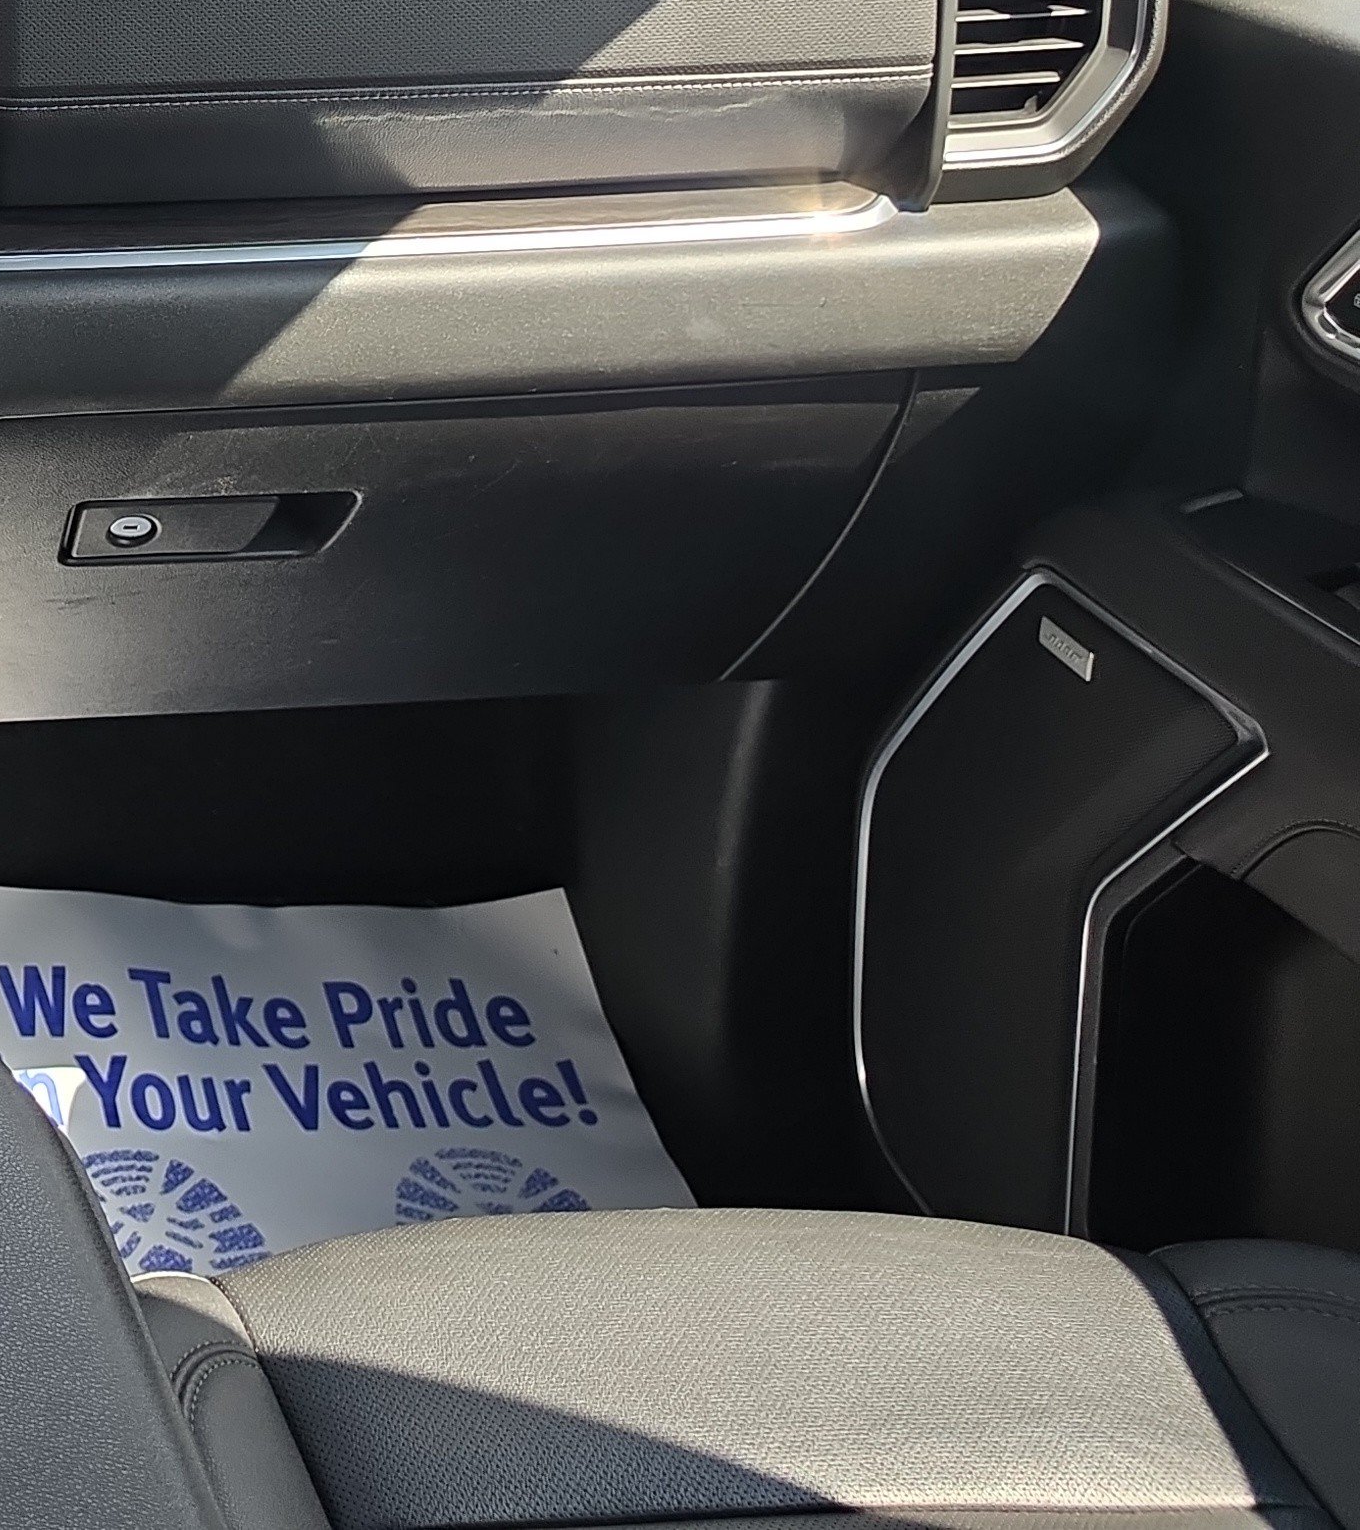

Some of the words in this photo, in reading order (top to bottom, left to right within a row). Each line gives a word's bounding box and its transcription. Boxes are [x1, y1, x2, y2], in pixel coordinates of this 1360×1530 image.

[128, 967, 311, 1048] Take
[324, 977, 536, 1050] Pride
[75, 1054, 252, 1133] Your
[263, 1058, 598, 1132] Vehicle!
